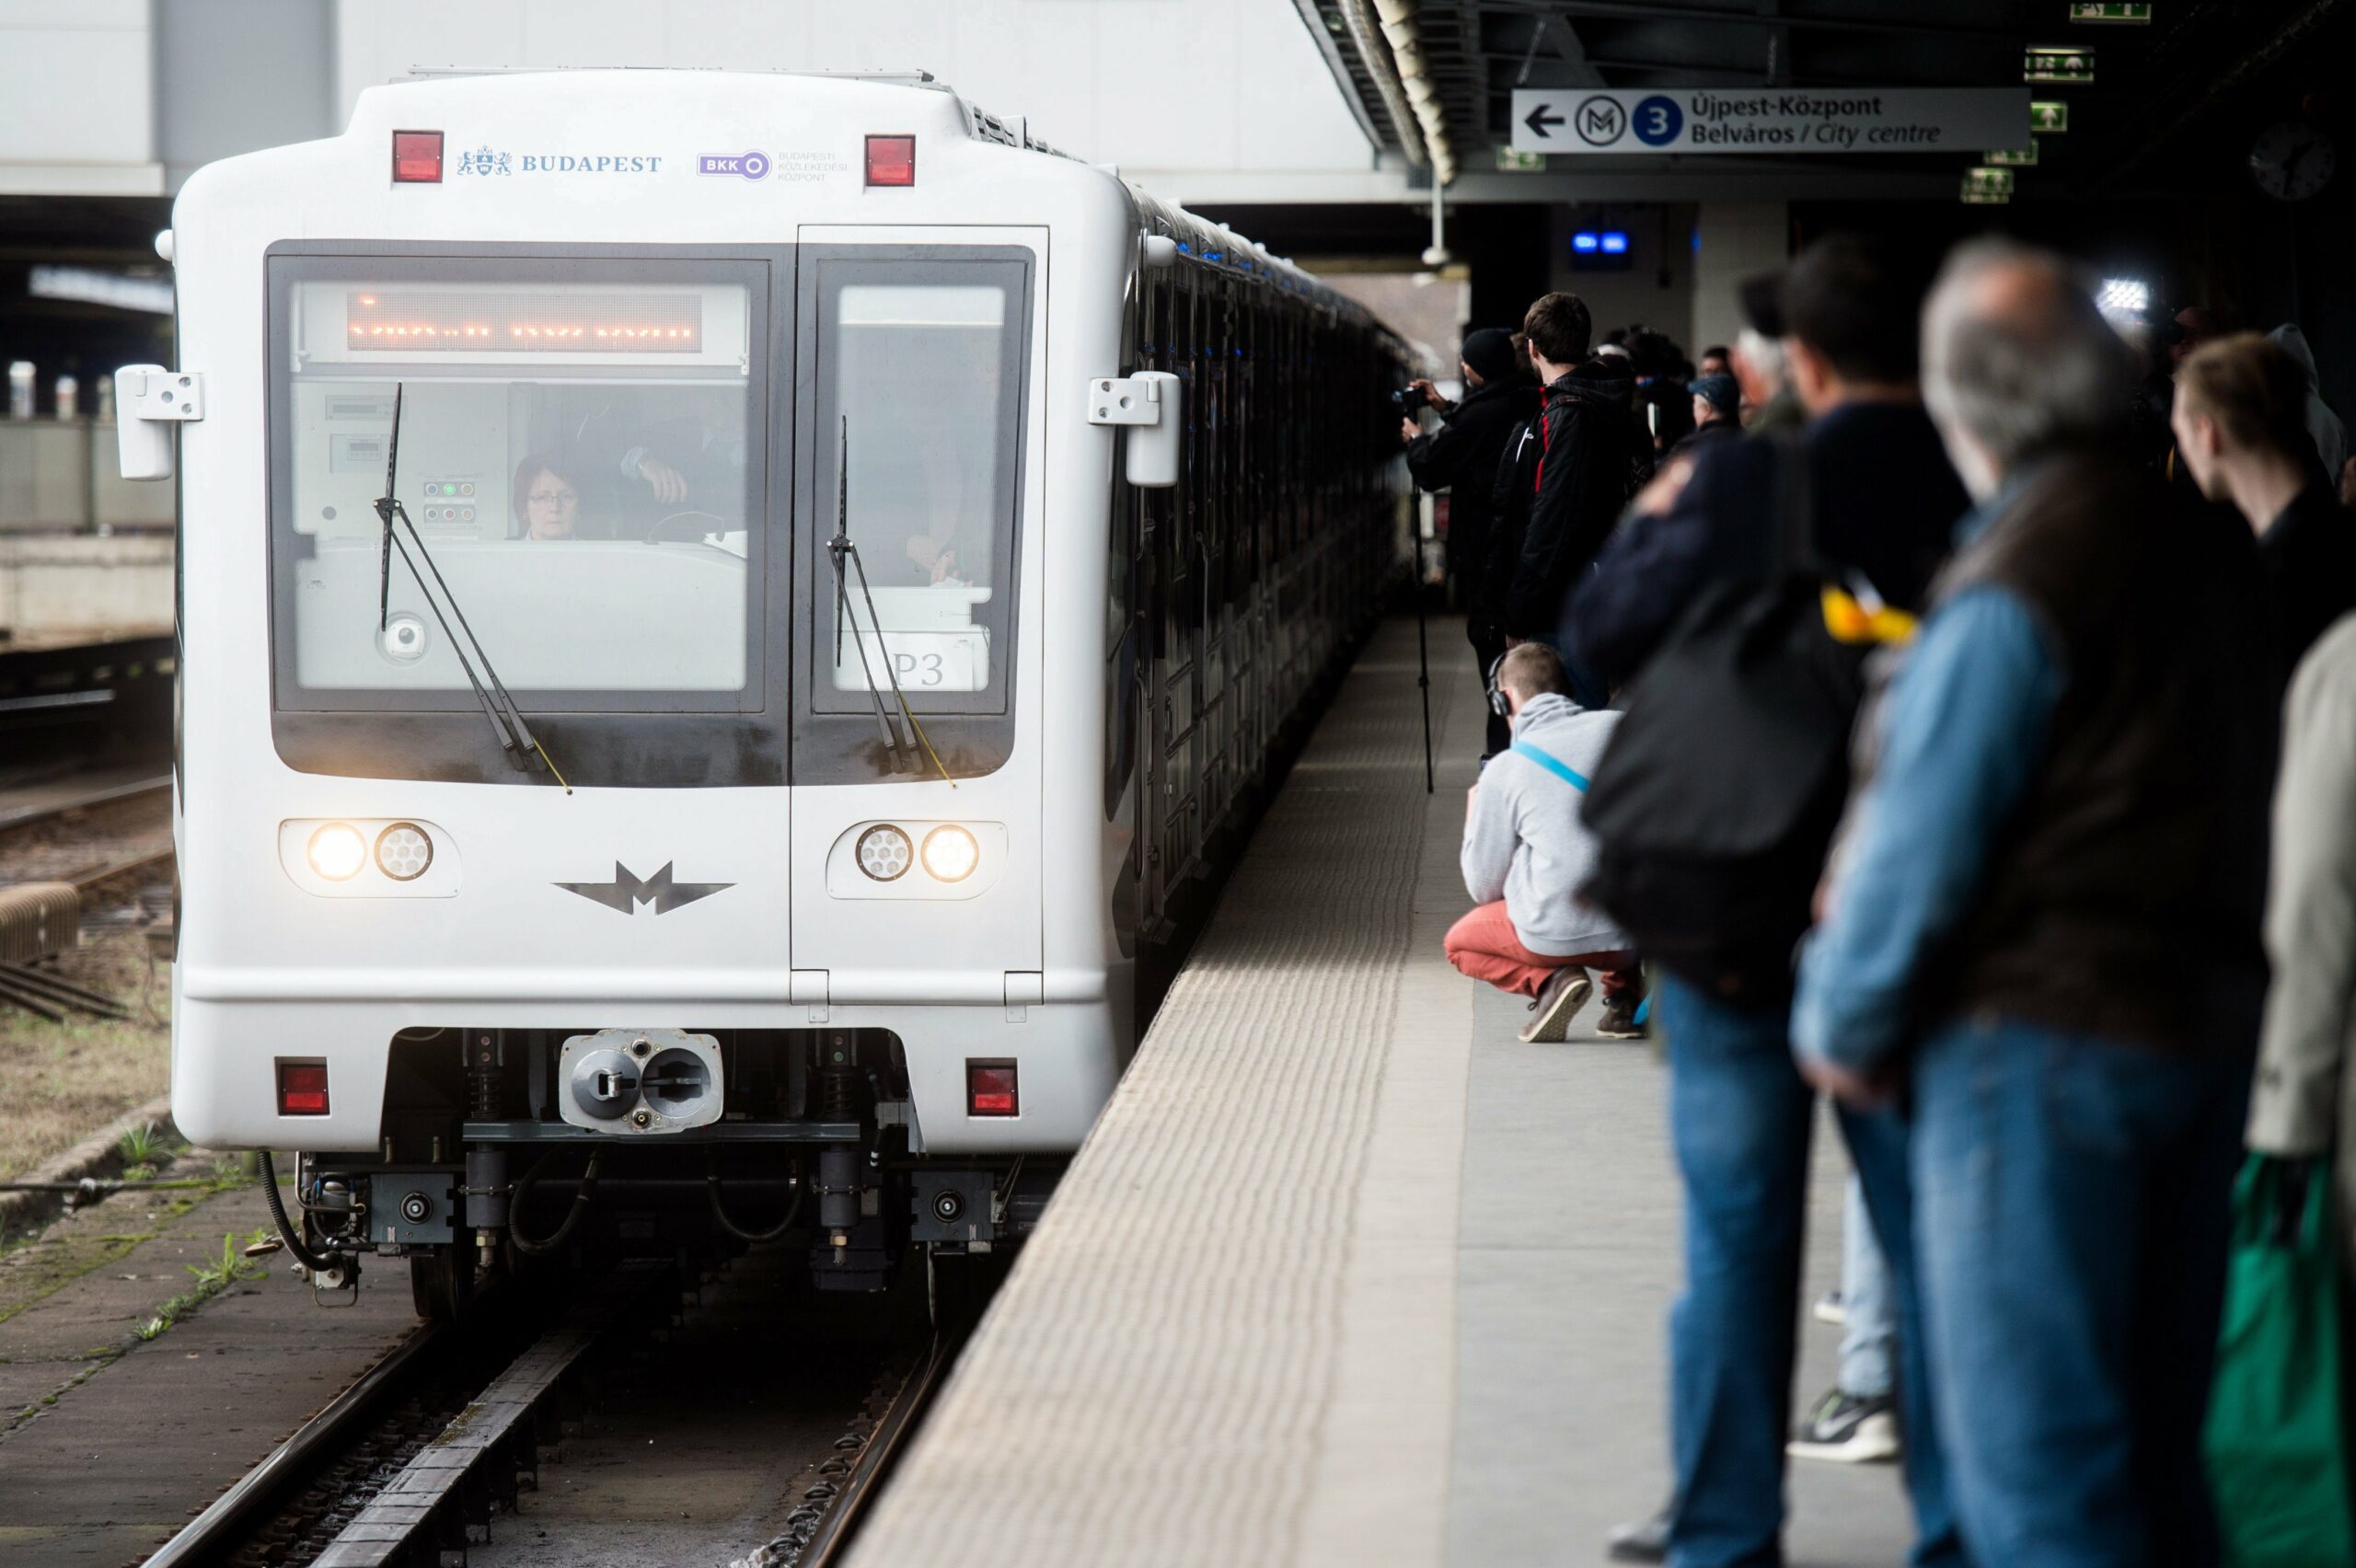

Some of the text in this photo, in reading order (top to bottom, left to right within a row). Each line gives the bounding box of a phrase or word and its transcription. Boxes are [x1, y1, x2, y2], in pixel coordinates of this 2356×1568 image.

[1647, 107, 1669, 136] 3
[1691, 90, 1883, 121] Újpest-Központ
[1692, 121, 1942, 149] Belváros / City centre
[521, 155, 662, 172] BUDAPEST
[706, 159, 739, 171] BKK
[779, 152, 836, 161] BUDAPESTI
[893, 653, 943, 686] P3
